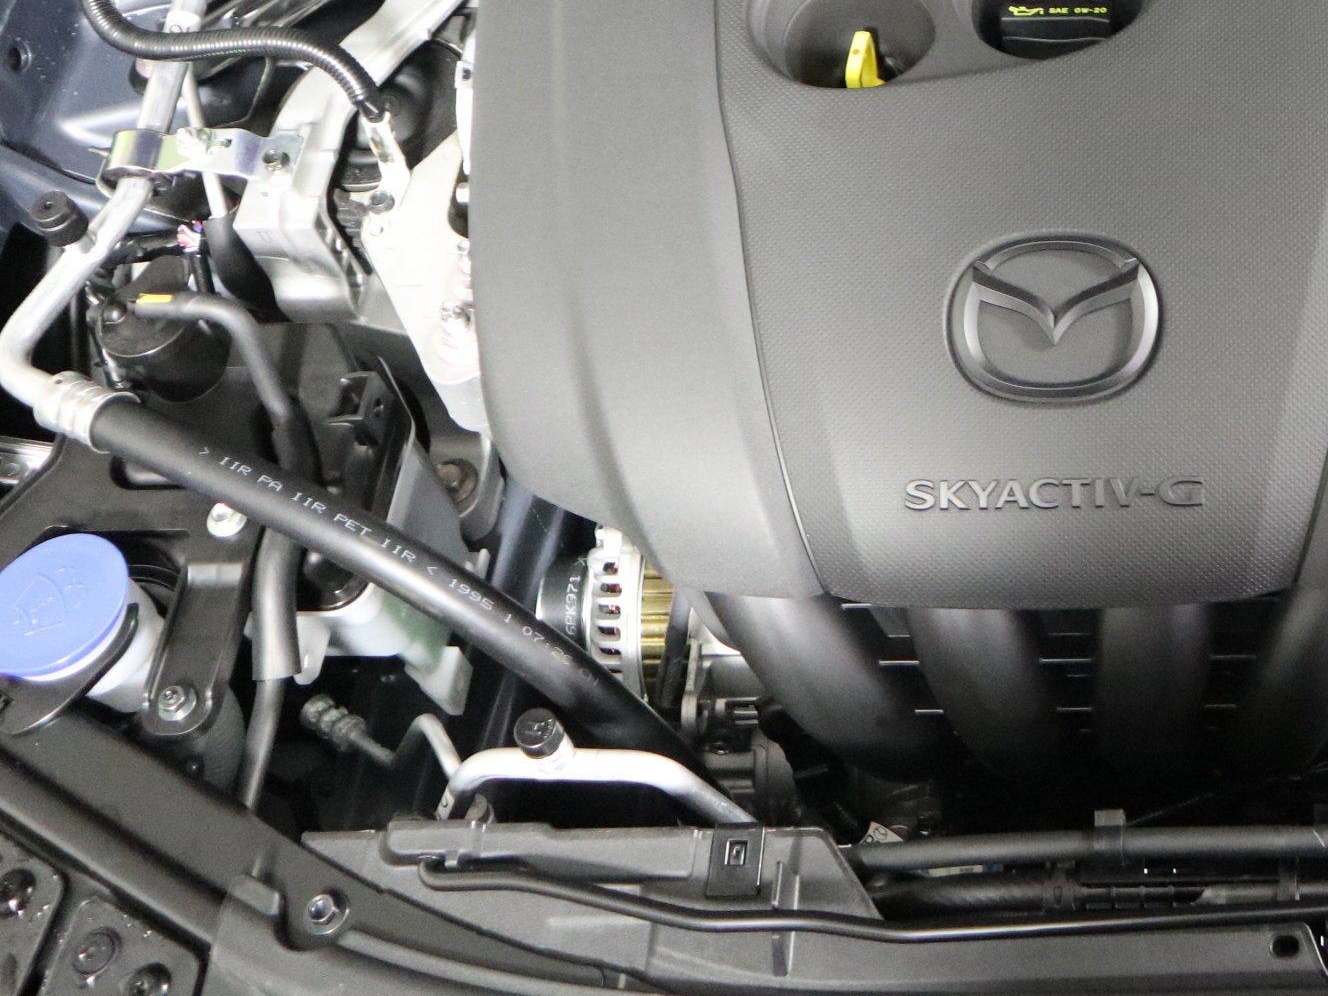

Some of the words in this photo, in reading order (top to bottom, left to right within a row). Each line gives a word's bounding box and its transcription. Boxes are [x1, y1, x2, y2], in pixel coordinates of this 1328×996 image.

[904, 476, 1203, 511] SKYACTIV-G
[219, 456, 252, 476] IIR
[257, 474, 284, 492] PA
[291, 491, 327, 514] IIR
[333, 512, 373, 536] PET
[380, 538, 416, 563] IIR
[449, 578, 494, 611] 1995
[565, 575, 580, 635] 6PK971
